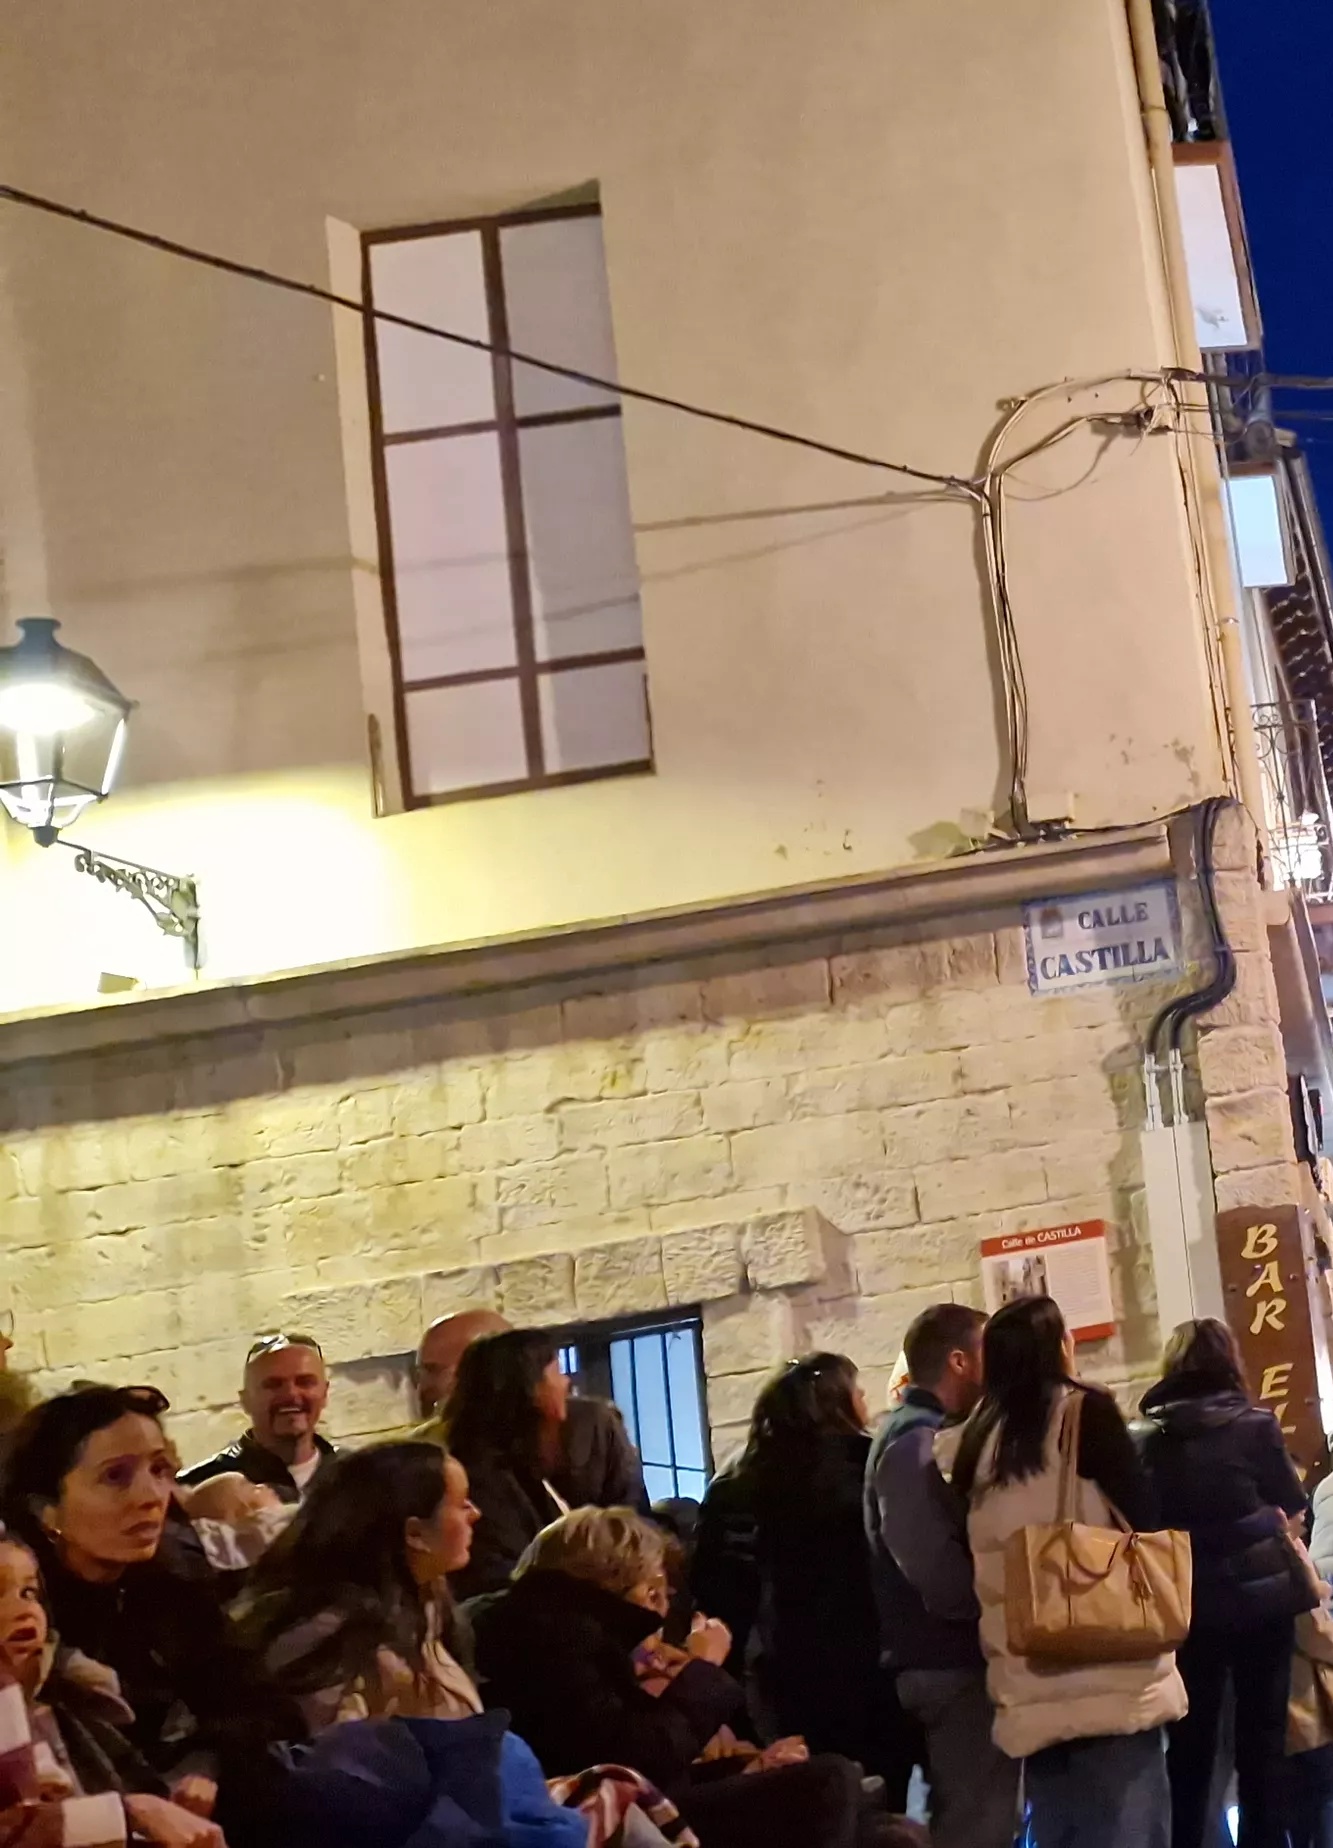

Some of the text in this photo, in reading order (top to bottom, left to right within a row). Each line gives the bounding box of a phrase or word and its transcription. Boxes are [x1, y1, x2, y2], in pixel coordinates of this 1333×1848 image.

[1078, 902, 1149, 930] CALLE
[1040, 937, 1171, 980] CASTILLA
[1002, 1226, 1082, 1249] Calle de CASTILLA
[1241, 1223, 1287, 1335] BAR
